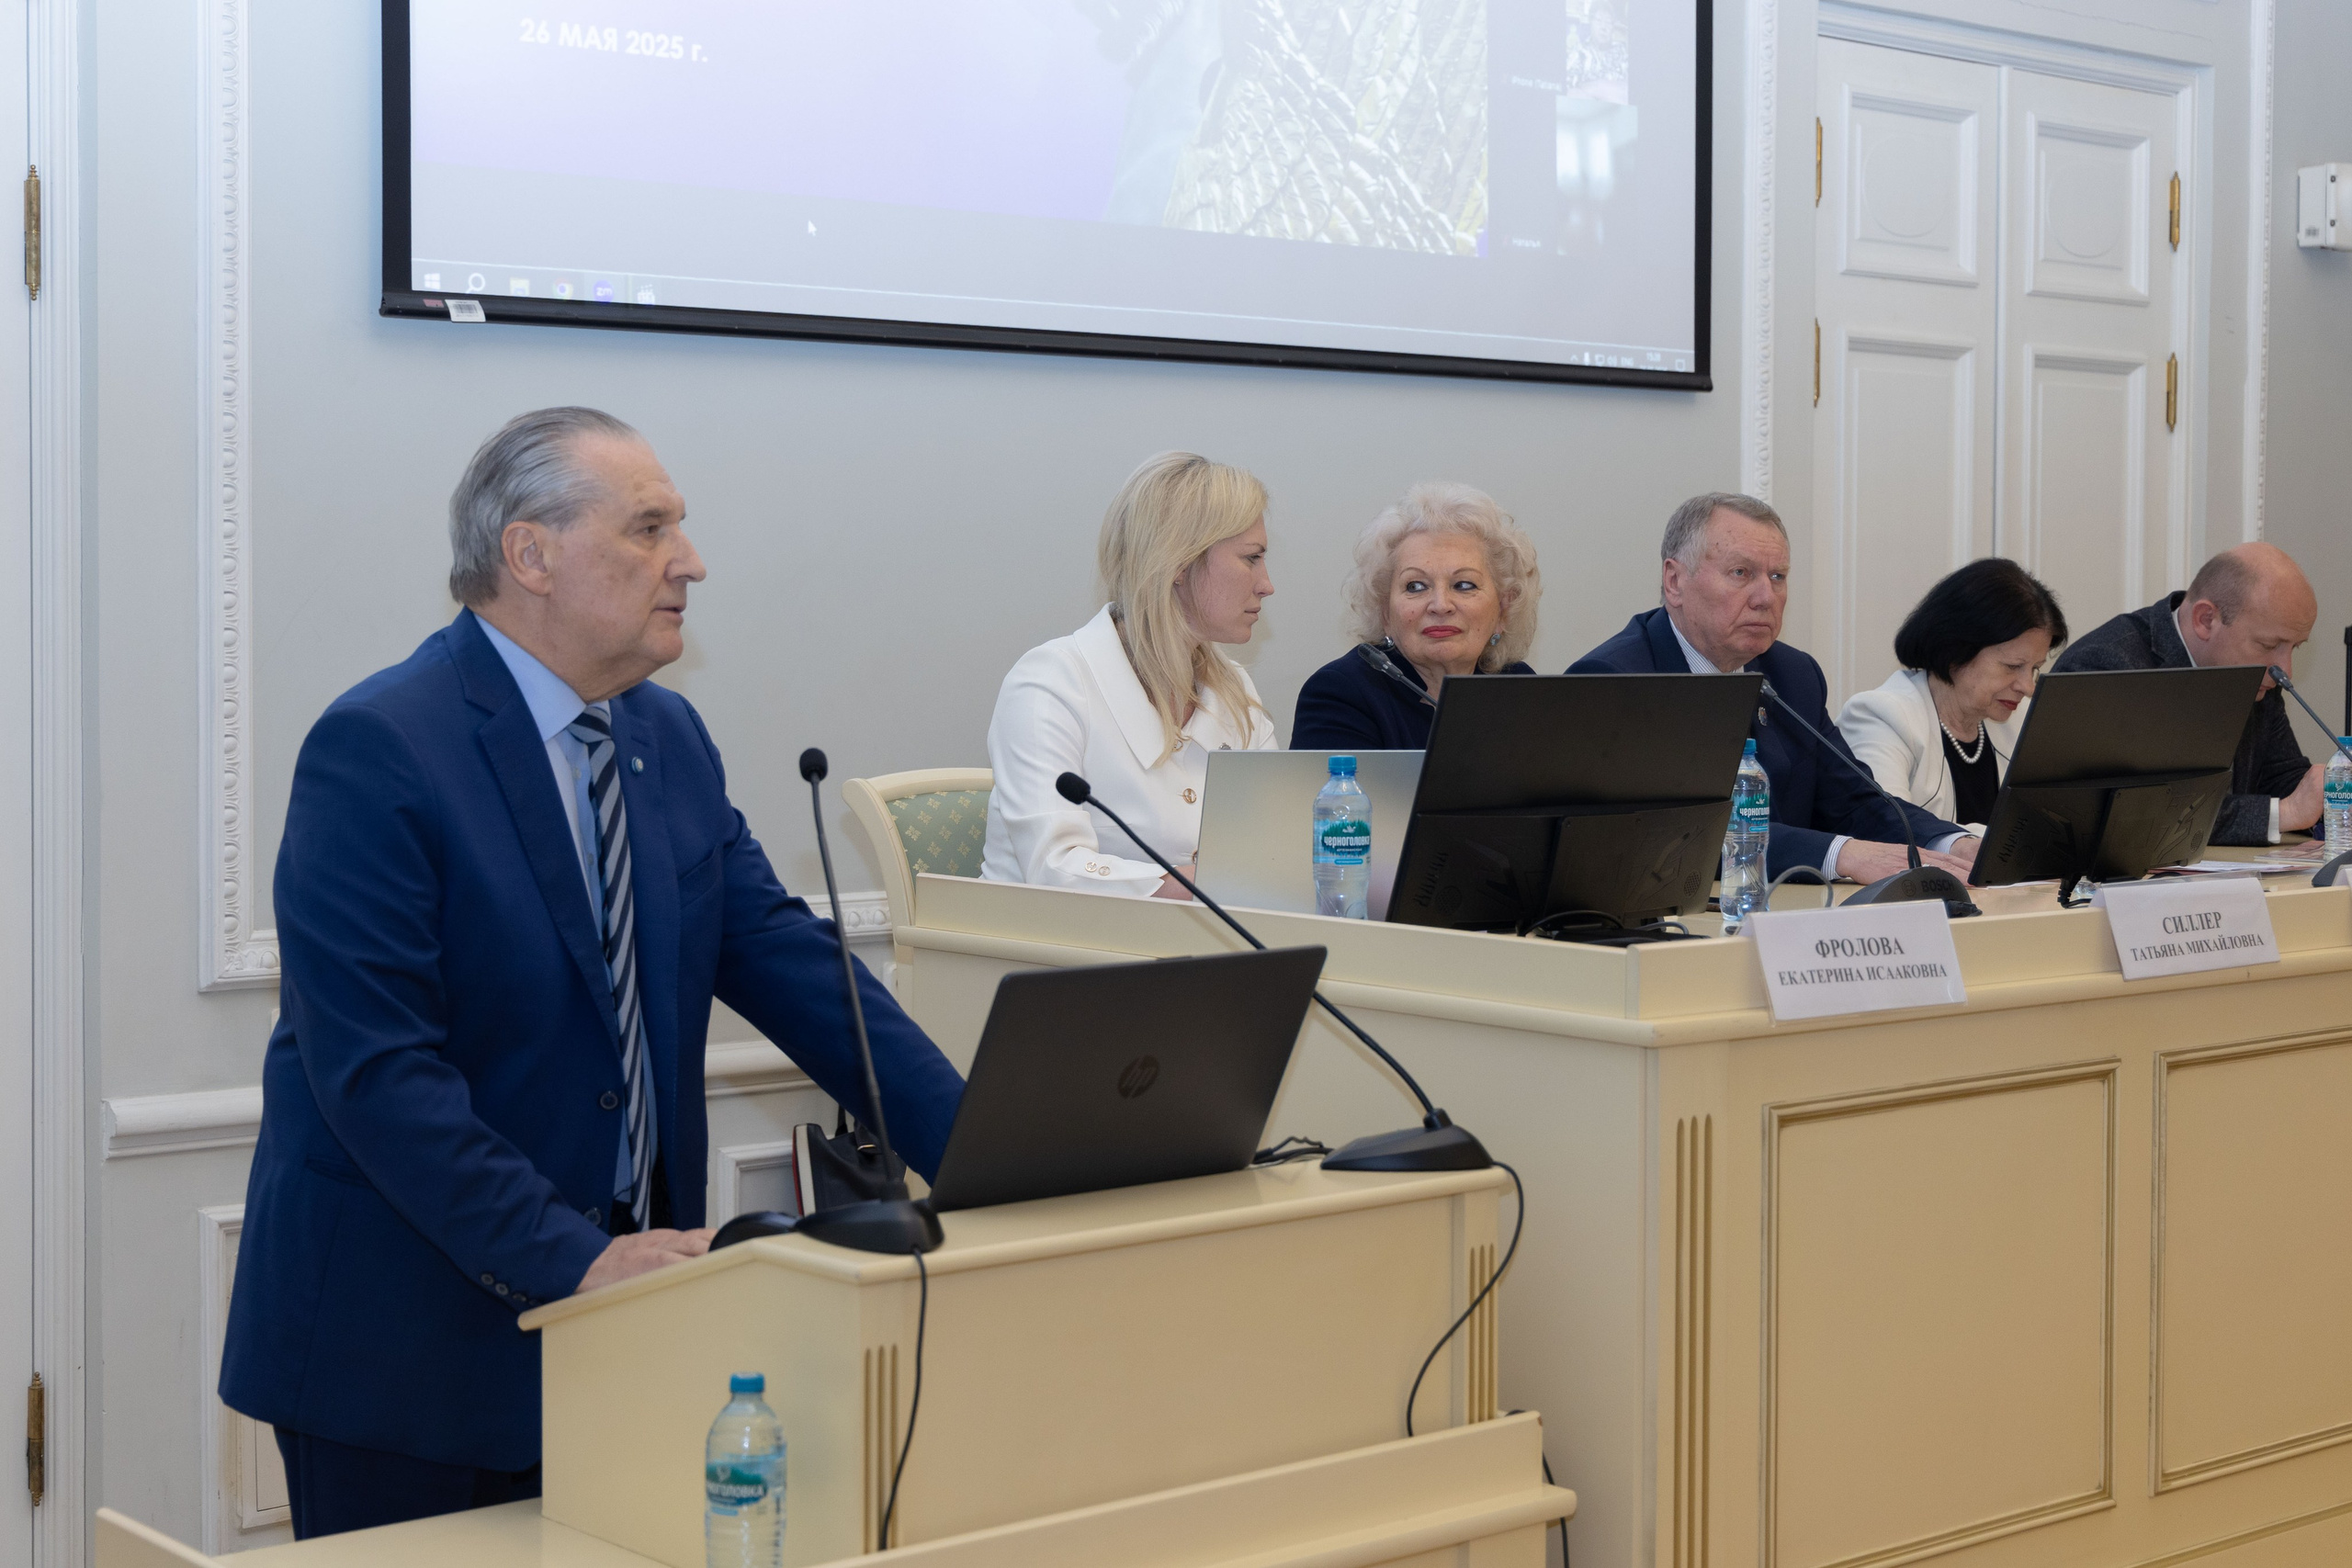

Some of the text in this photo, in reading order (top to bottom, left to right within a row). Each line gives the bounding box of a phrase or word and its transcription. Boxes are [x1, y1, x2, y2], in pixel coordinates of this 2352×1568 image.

[519, 17, 708, 62] 26 МАЯ 2025 г.
[1921, 879, 1955, 892] BOSCH
[2162, 911, 2222, 934] СИЛЛЕР
[1815, 937, 1905, 958] ФРОЛОВА
[2131, 933, 2264, 961] ТАТЬЯНА МИХАЙЛОВНА
[1778, 964, 1948, 986] ЕКАТЕРИНА ИСААКОВНА
